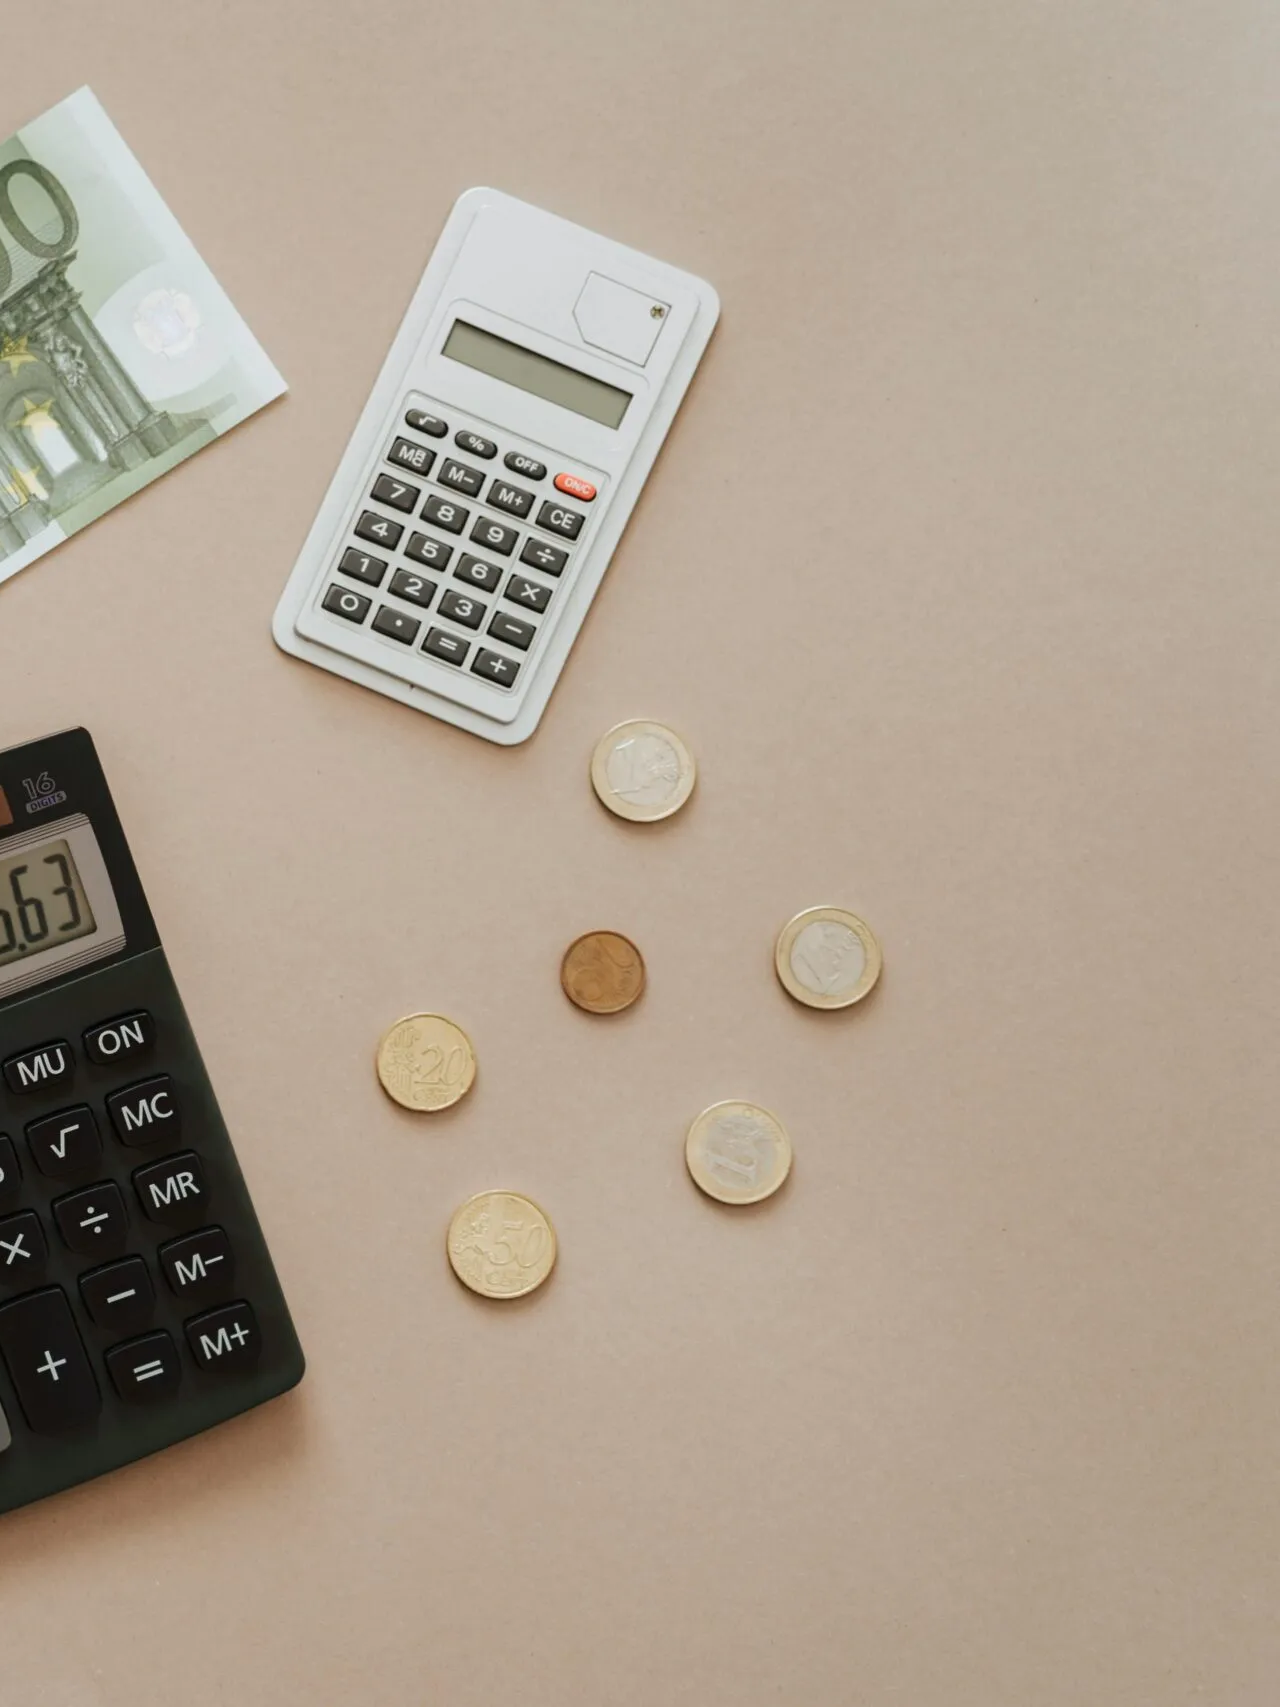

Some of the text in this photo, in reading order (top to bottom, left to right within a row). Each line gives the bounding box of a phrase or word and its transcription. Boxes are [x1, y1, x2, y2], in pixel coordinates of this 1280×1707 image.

[515, 455, 539, 471] OFF
[390, 483, 406, 498] 7
[498, 486, 524, 506] M+
[437, 505, 455, 522] 8
[550, 507, 576, 529] CE
[371, 522, 388, 537] 4
[487, 526, 504, 543] 9
[421, 541, 439, 558] 5
[361, 558, 370, 572] 1
[471, 563, 488, 579] 6
[405, 577, 423, 596] 2
[340, 594, 359, 611] 0
[455, 597, 474, 617] 3
[22, 771, 56, 800] 16
[28, 791, 65, 812] DIGITS
[99, 1021, 143, 1054] ON
[17, 1049, 64, 1085] MU
[414, 1044, 468, 1087] 20
[122, 1093, 173, 1130] MC
[149, 1172, 200, 1207] MR
[488, 1221, 550, 1269] 50
[200, 1323, 248, 1359] M+
